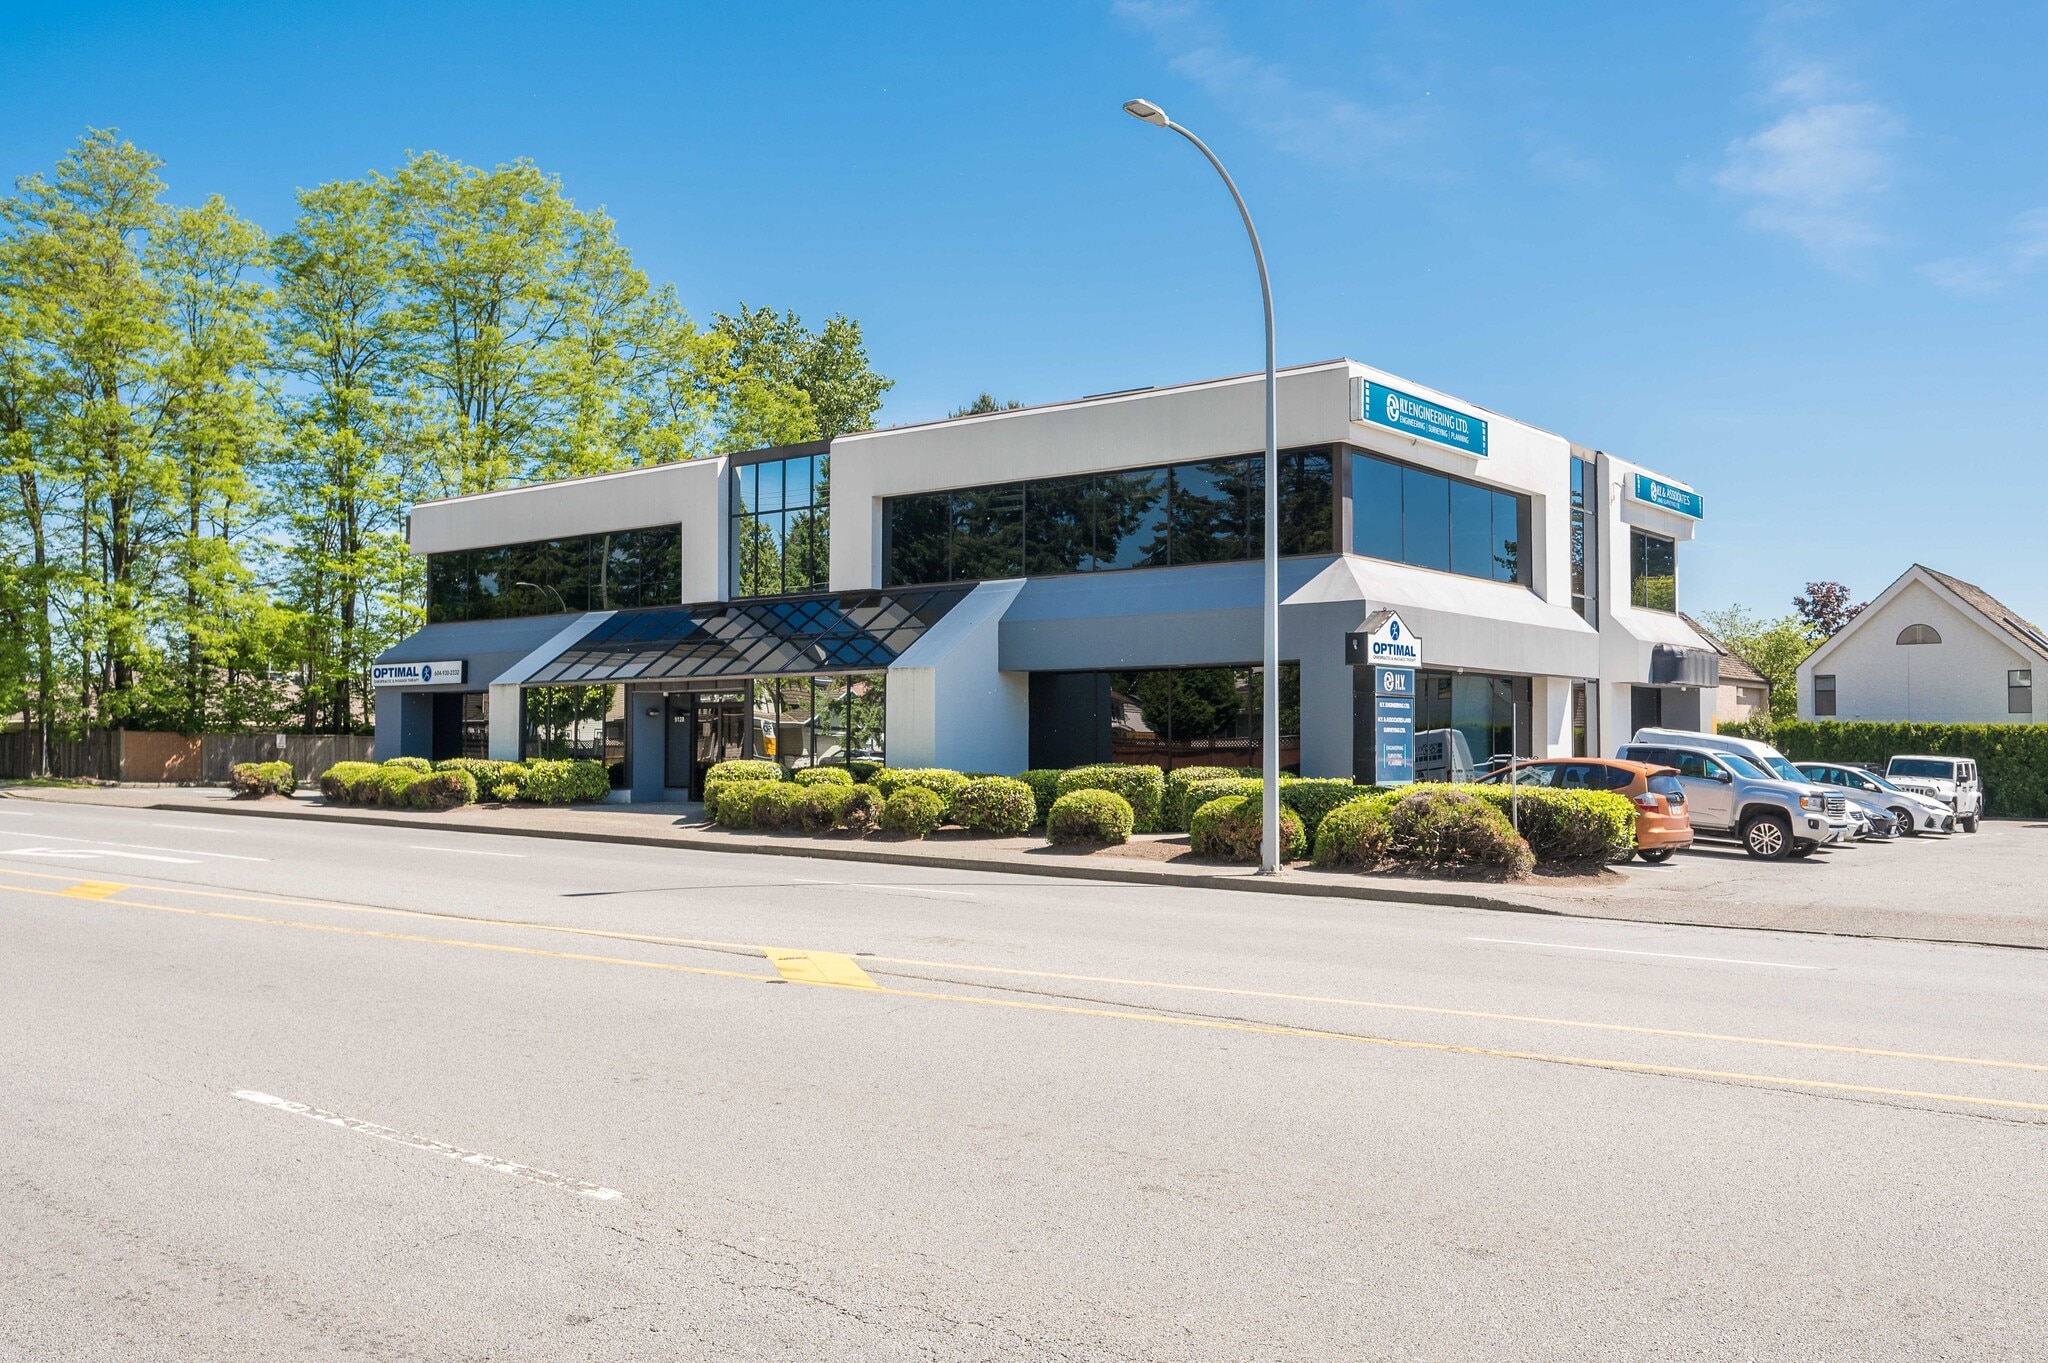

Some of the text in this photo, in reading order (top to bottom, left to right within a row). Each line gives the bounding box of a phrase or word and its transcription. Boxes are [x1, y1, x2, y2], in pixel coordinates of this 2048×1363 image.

[1408, 402, 1455, 429] ENGINEERING
[1455, 417, 1469, 434] LTD.
[1399, 415, 1469, 444] ENGINEERING SURVEYING PLANNING
[1666, 489, 1690, 506] ASSOCIATES
[1373, 642, 1416, 657] OPTIMAL
[374, 667, 419, 678] OPTIMAL
[1395, 674, 1406, 690] H.Y.
